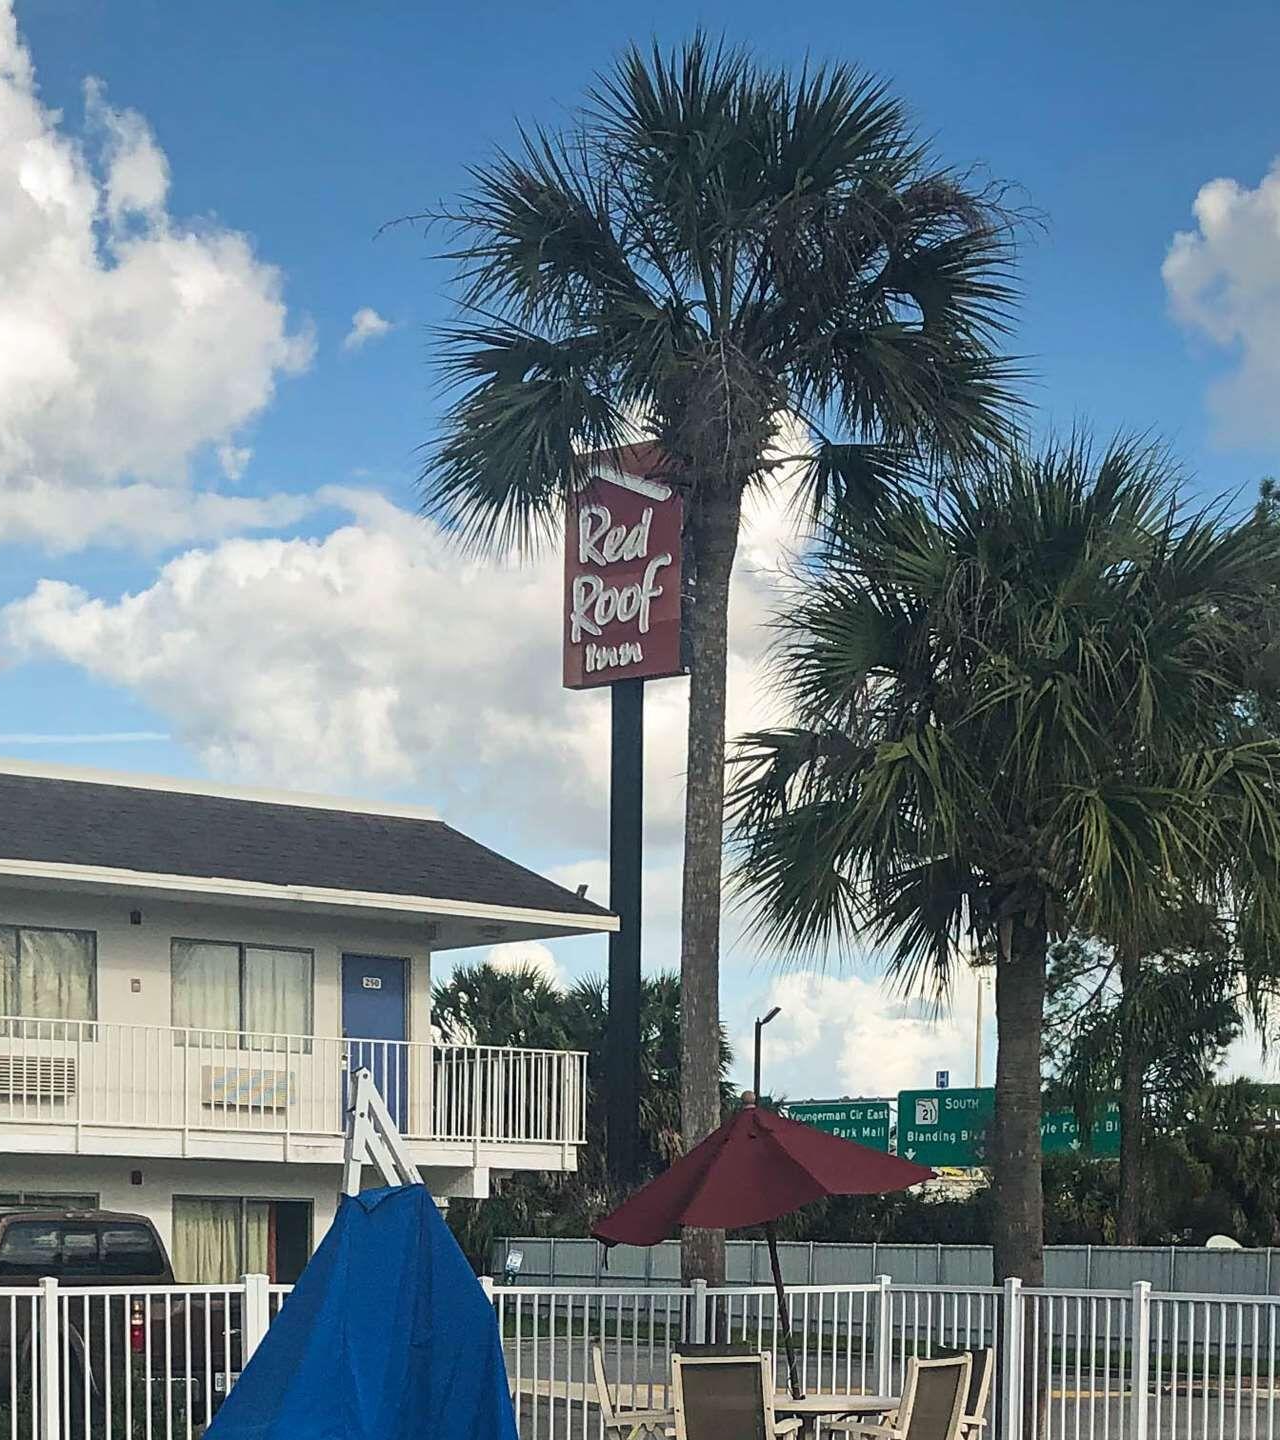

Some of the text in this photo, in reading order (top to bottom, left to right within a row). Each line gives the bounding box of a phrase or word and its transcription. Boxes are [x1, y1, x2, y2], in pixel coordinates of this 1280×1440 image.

[578, 505, 652, 566] Red
[571, 553, 672, 643] Roof
[585, 642, 643, 673] Inn
[789, 1104, 888, 1123] Youngerman Cir East
[922, 1109, 933, 1121] 21
[833, 1127, 885, 1138] Park Mall
[907, 1130, 956, 1143] Blanding
